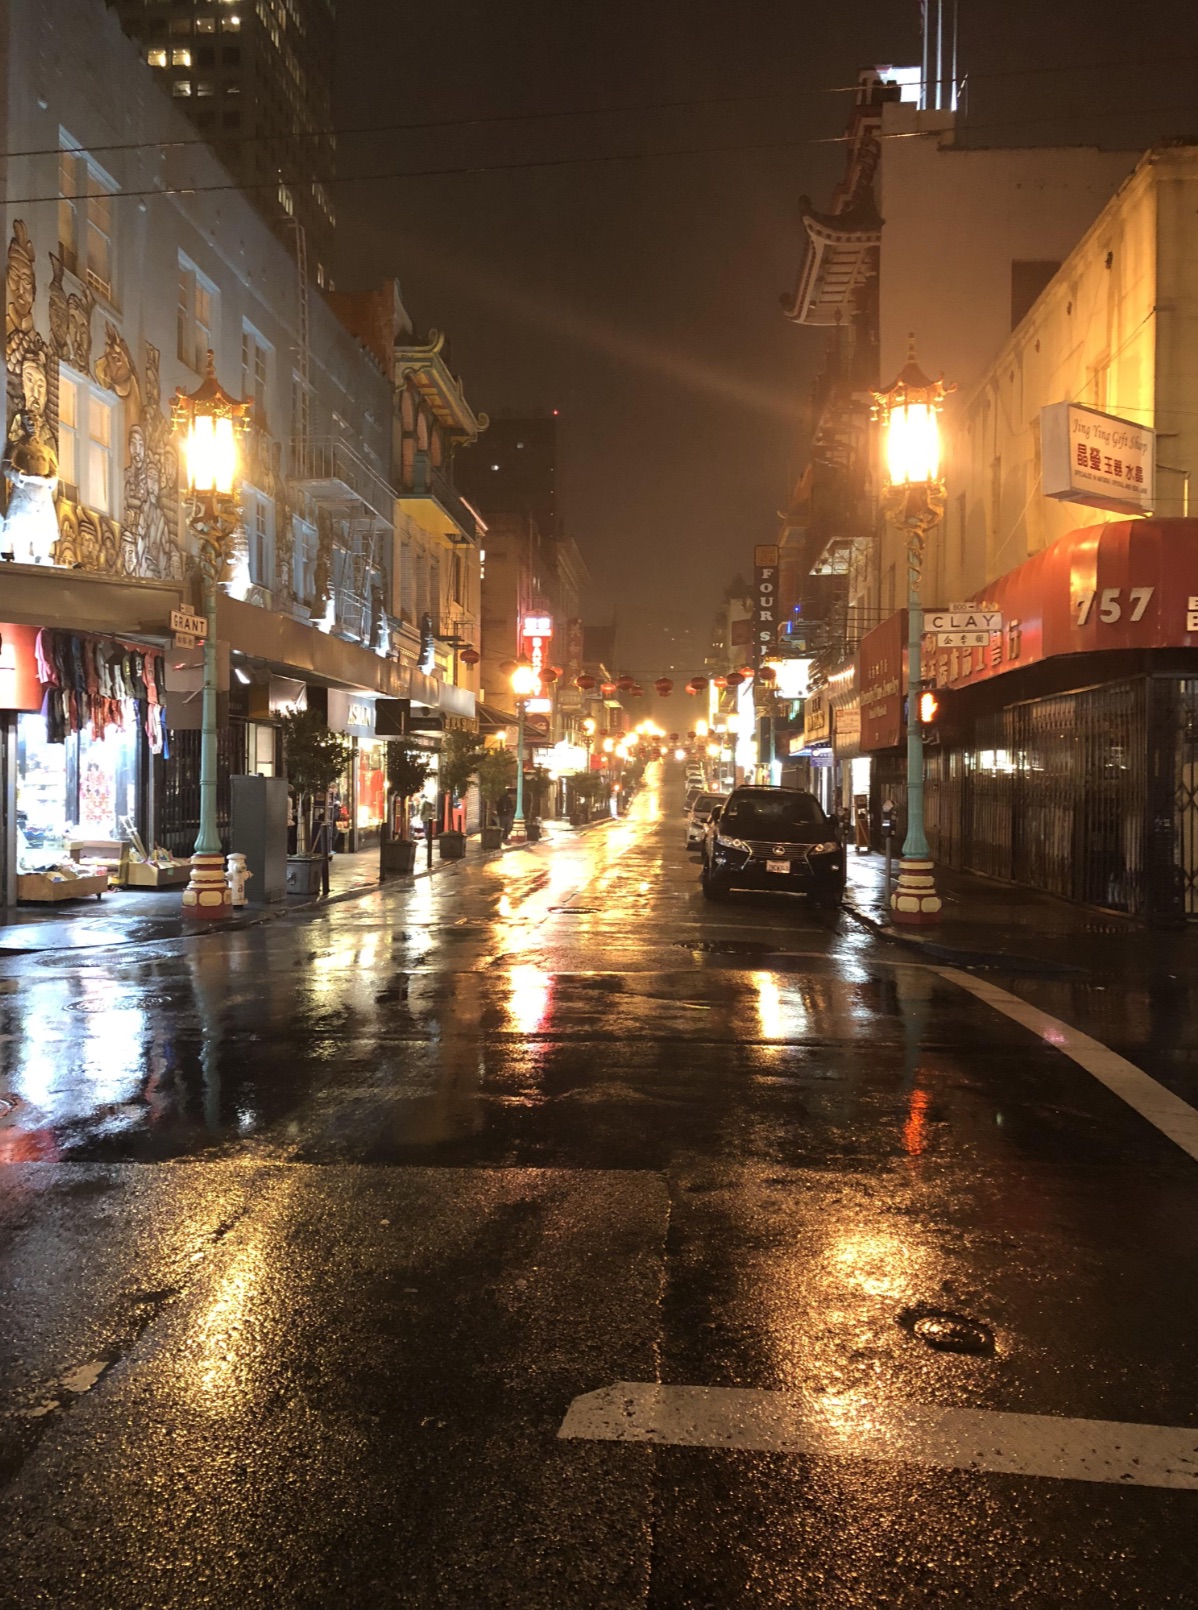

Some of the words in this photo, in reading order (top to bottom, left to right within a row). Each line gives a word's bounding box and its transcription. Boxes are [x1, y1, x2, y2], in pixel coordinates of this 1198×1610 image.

[1073, 418, 1091, 440] Jing
[1093, 424, 1111, 446] Ying
[1112, 431, 1128, 449] Gift
[1129, 436, 1148, 456] Shop
[759, 568, 774, 621] FOUR
[1077, 587, 1155, 626] 757
[174, 614, 204, 633] GRANT
[932, 614, 995, 629] CLAY
